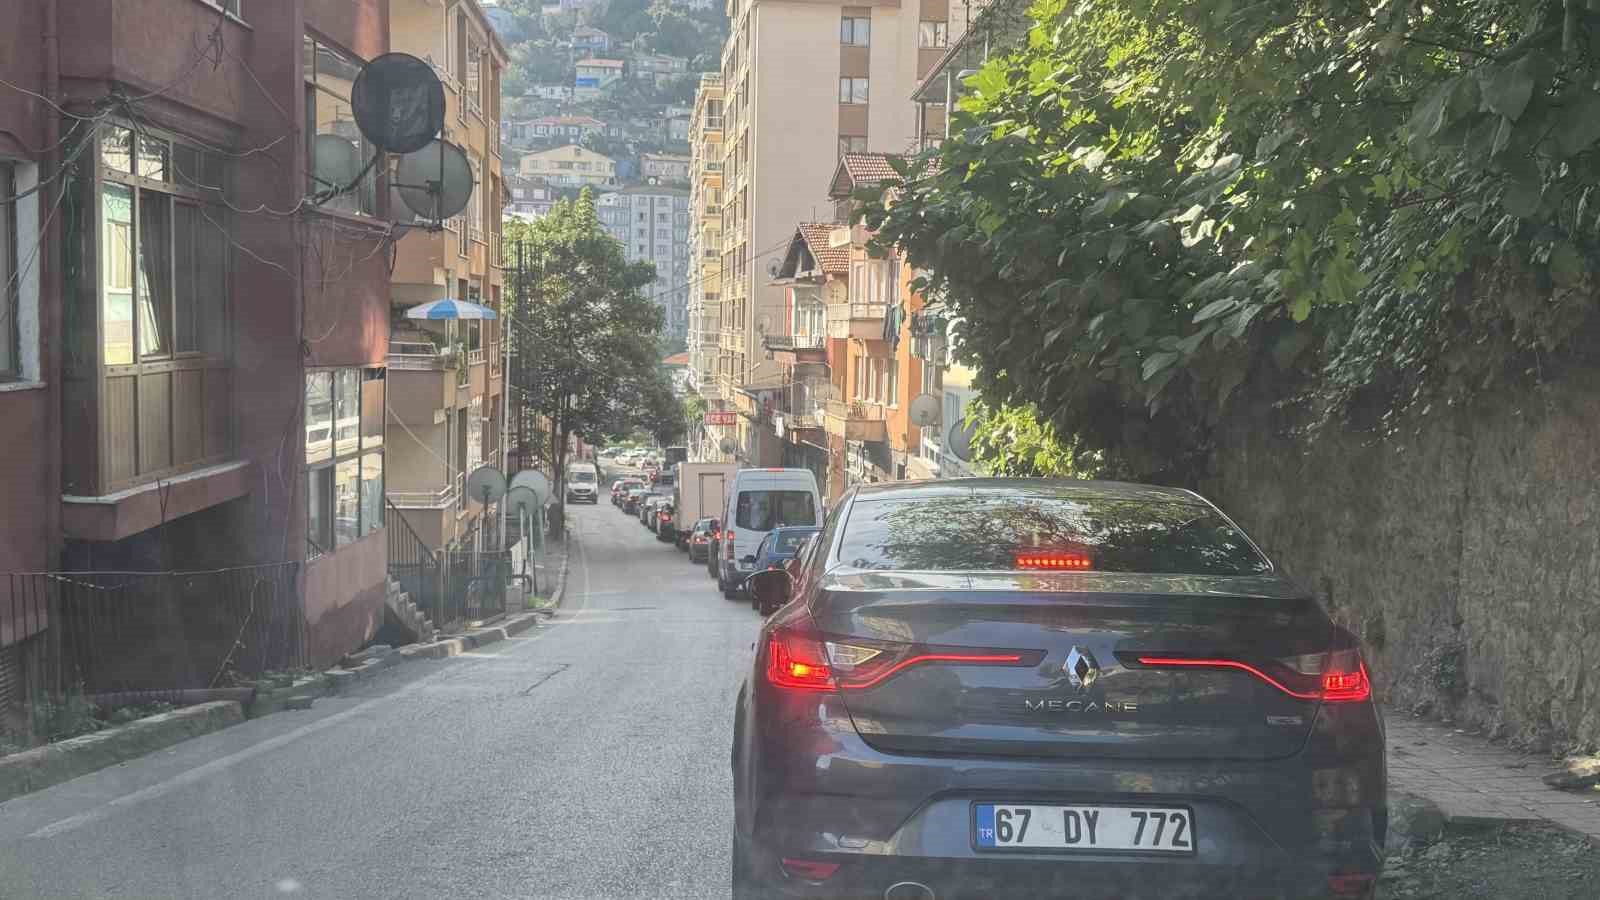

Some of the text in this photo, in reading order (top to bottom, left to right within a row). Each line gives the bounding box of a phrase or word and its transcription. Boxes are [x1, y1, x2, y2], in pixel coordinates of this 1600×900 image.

[979, 827, 993, 840] TR
[995, 808, 1189, 848] 67 DY 772
